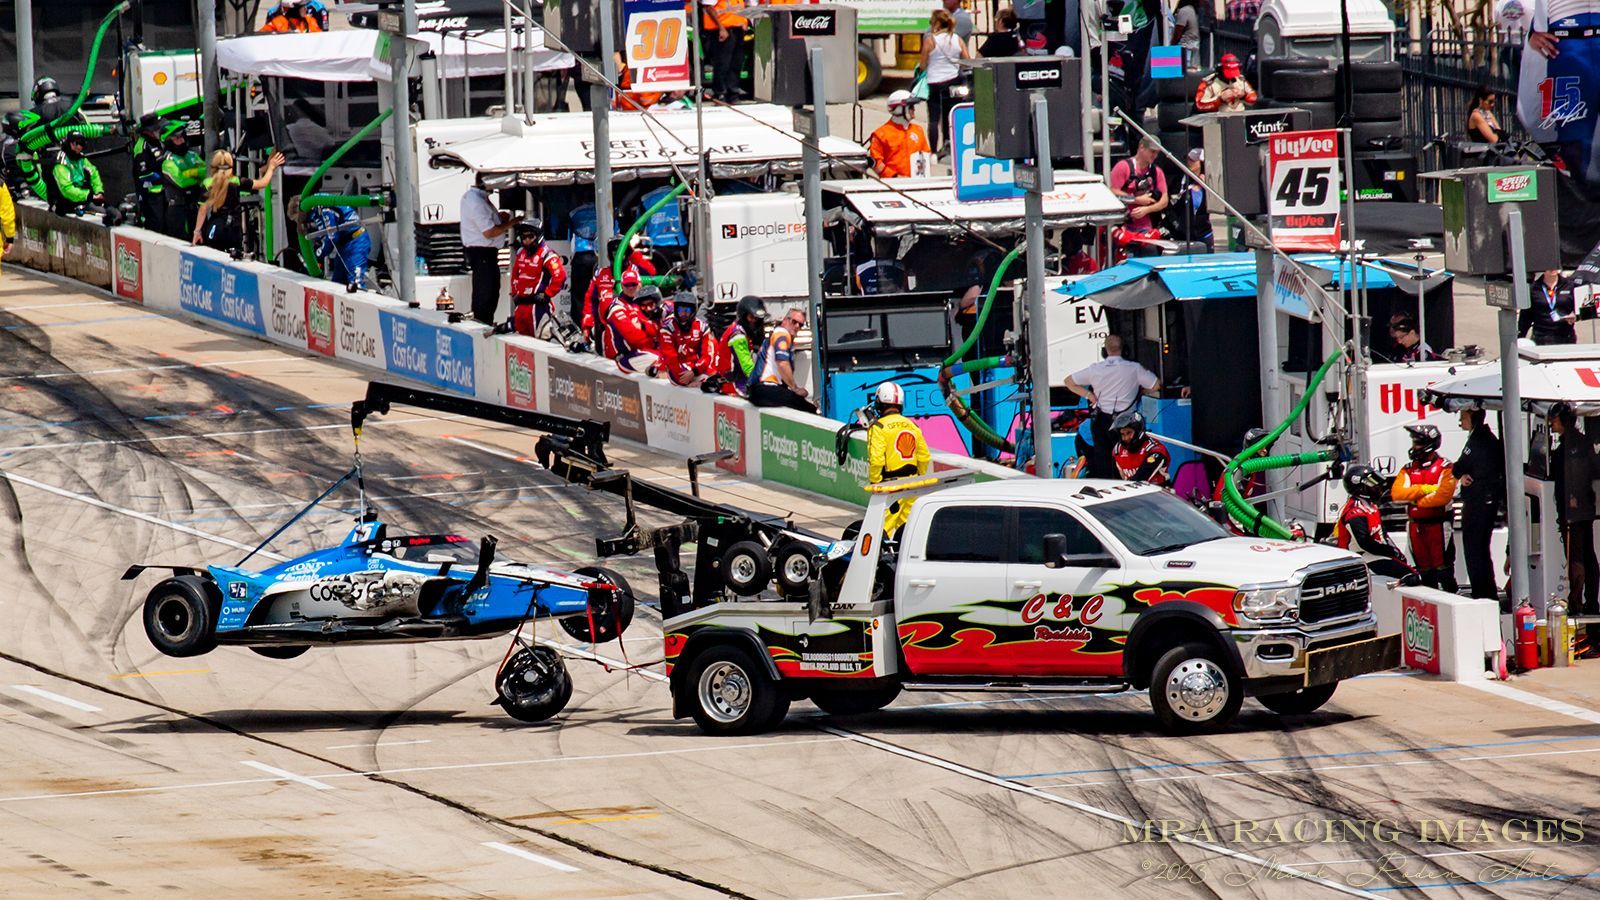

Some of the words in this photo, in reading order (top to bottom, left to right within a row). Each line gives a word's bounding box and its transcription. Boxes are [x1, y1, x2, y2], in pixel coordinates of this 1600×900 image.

[418, 16, 469, 31] MI-JACK
[632, 17, 682, 61] 30
[1018, 69, 1060, 80] GEICO
[1537, 76, 1580, 120] 15
[580, 139, 648, 150] FEET
[658, 149, 677, 158] &
[684, 144, 753, 156] CARE
[1274, 137, 1333, 157] HyVee
[1275, 166, 1331, 207] 45
[1502, 175, 1530, 185] SPEEDY
[1502, 182, 1527, 191] CASH
[221, 268, 236, 294] FLEET
[221, 293, 235, 319] COST
[240, 299, 256, 326] CARE
[272, 284, 287, 310] FLEET
[272, 307, 287, 335] COST
[292, 314, 307, 341] CARE
[340, 301, 355, 328] FLEET
[340, 327, 355, 352] COST
[361, 332, 376, 358] CARE
[392, 317, 407, 343] FLEET
[436, 329, 452, 356] FLEET
[392, 342, 407, 368] COST
[411, 347, 427, 374] CARE
[436, 355, 451, 380] COST
[456, 360, 473, 387] CARE
[555, 375, 592, 406] peopleready
[603, 388, 639, 420] peopleready
[653, 398, 691, 433] peopleready
[768, 431, 798, 460] Capstone
[807, 441, 837, 471] Capstone
[352, 523, 375, 543] 15
[1327, 578, 1358, 595] RAM
[1021, 594, 1047, 625] C
[1053, 593, 1073, 620] &
[1080, 594, 1105, 626] C
[1034, 625, 1092, 642] Roadside
[1406, 607, 1434, 660] O'Reilly
